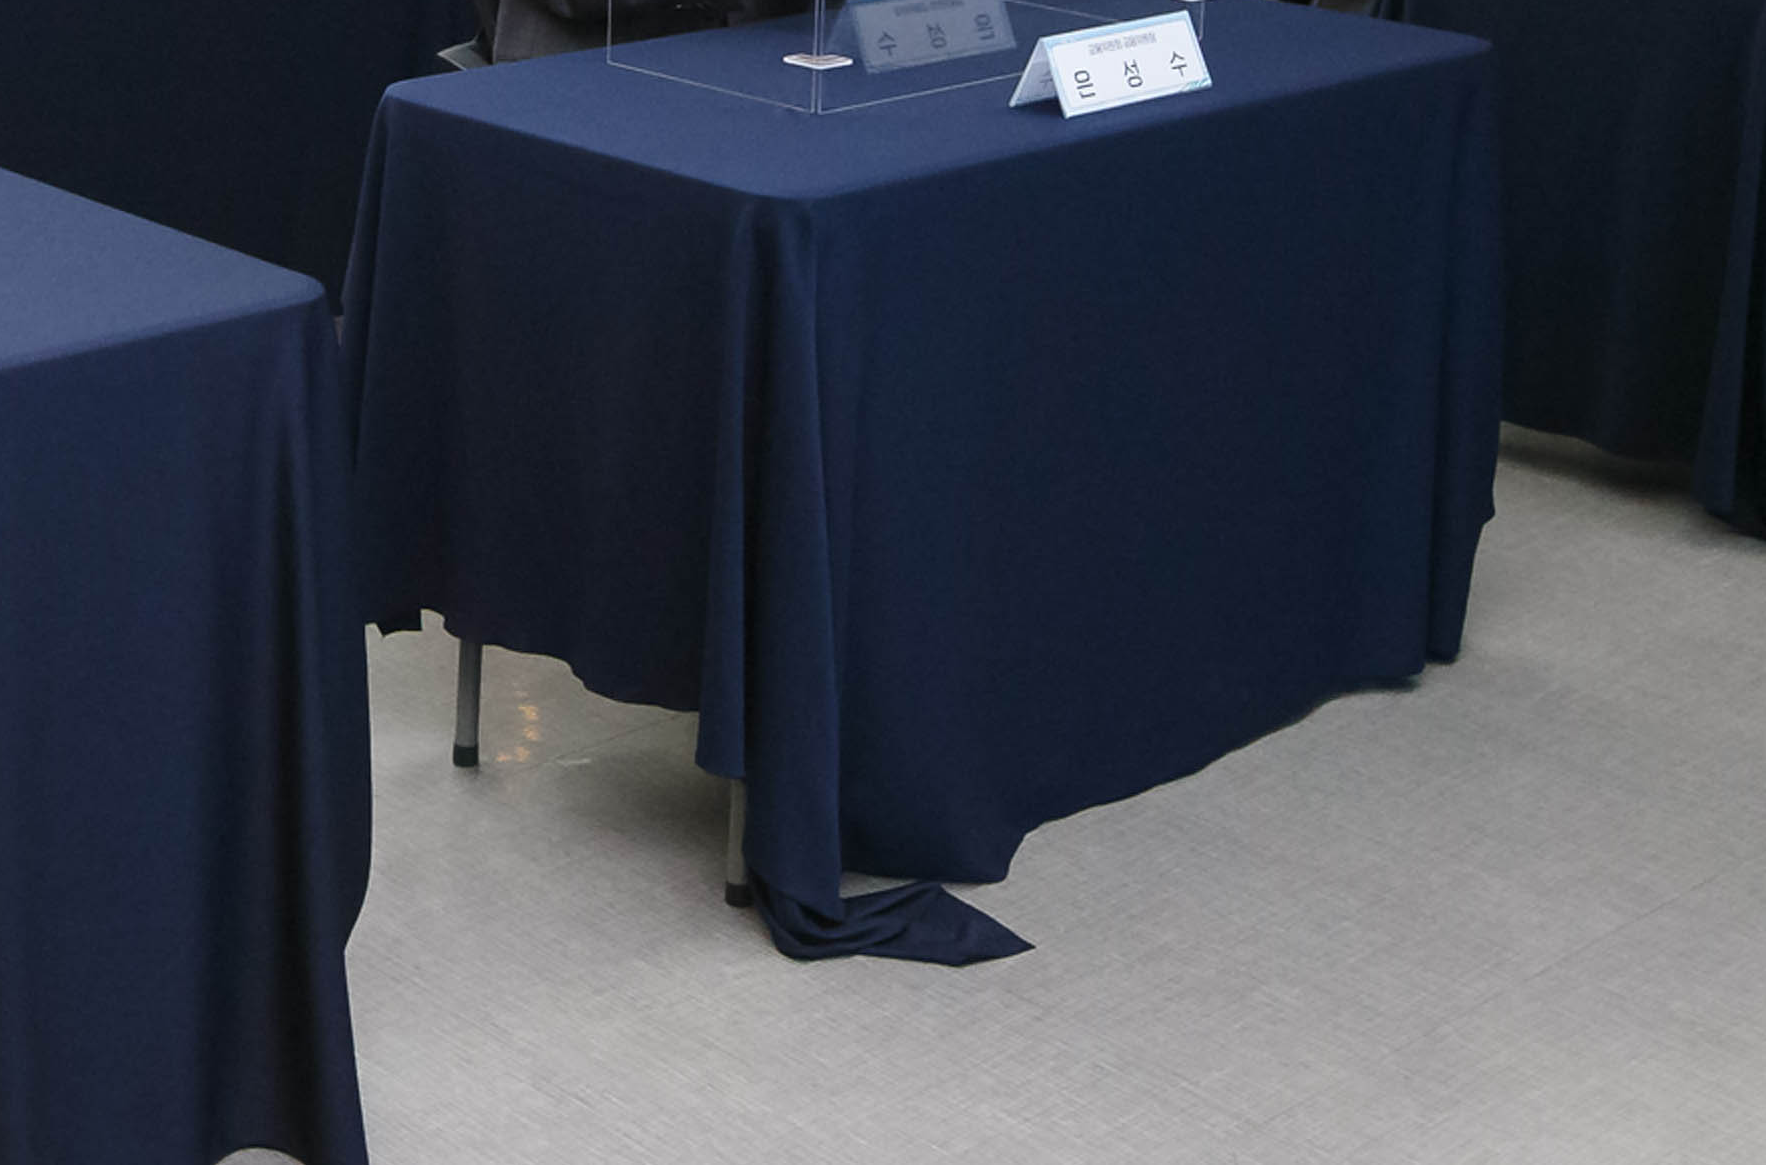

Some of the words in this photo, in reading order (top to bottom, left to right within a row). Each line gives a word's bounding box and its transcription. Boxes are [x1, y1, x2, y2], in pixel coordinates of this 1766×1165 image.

[1074, 69, 1096, 99] 은
[1124, 58, 1143, 88] 성
[1170, 50, 1188, 77] 수
